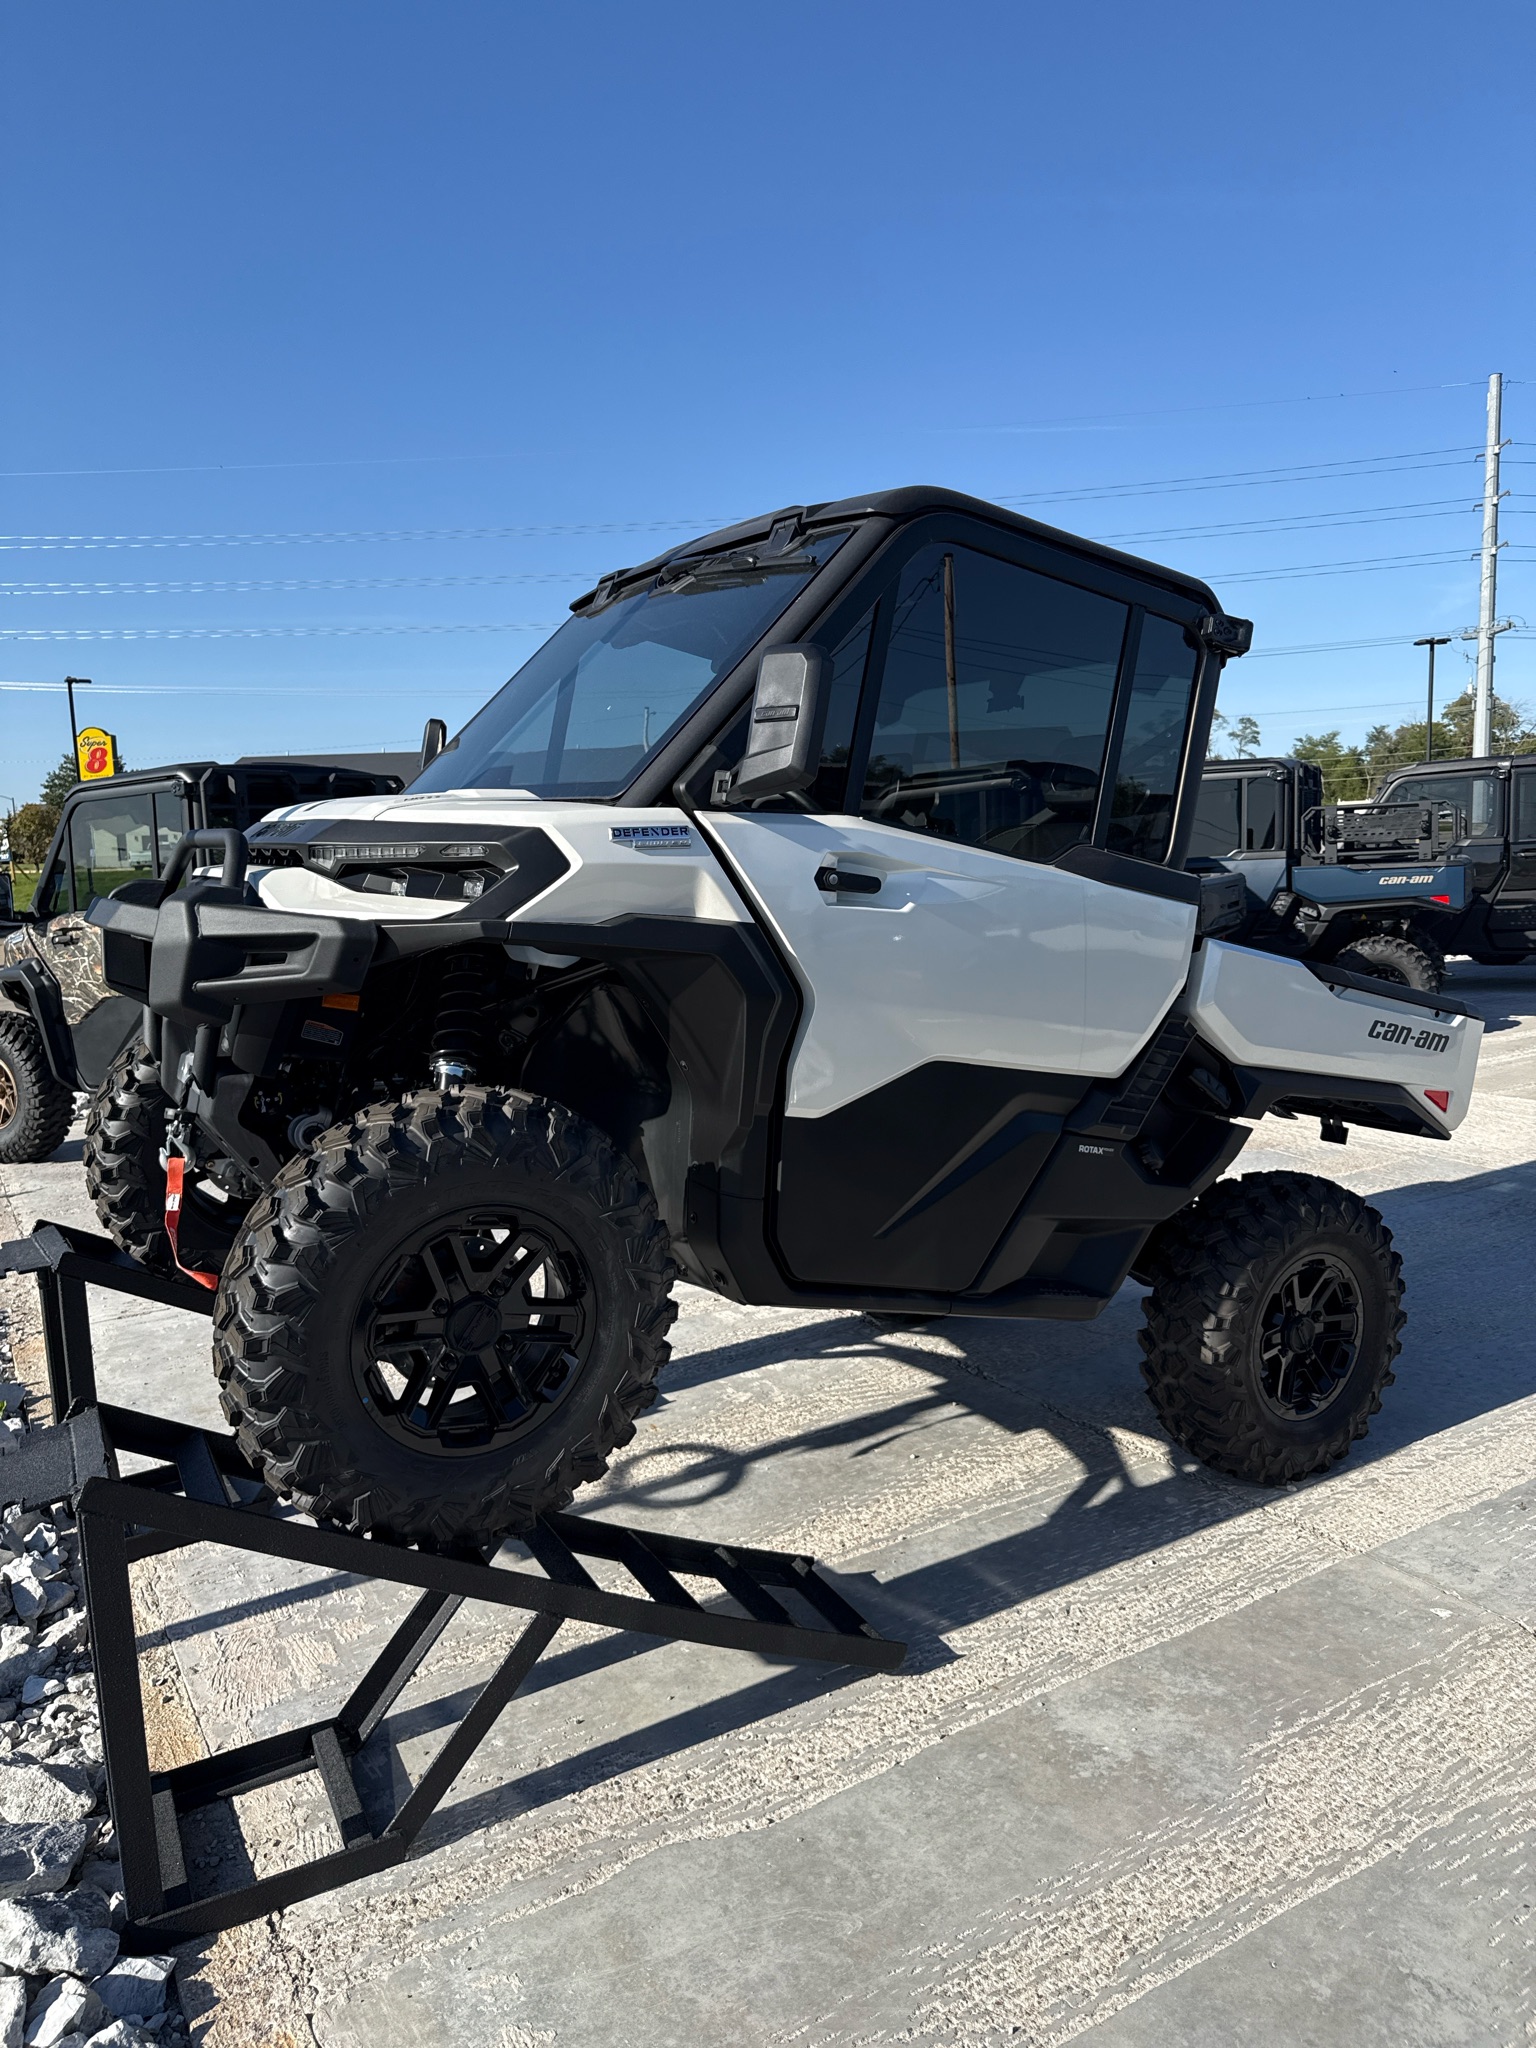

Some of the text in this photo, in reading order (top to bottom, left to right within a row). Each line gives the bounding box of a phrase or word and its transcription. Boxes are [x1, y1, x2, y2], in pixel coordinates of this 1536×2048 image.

[80, 736, 107, 752] Super
[85, 747, 108, 773] 8
[613, 827, 689, 837] DEFENDER
[1378, 875, 1434, 885] can-am
[1367, 1019, 1450, 1053] can-am
[1078, 1144, 1104, 1155] ROTAX
